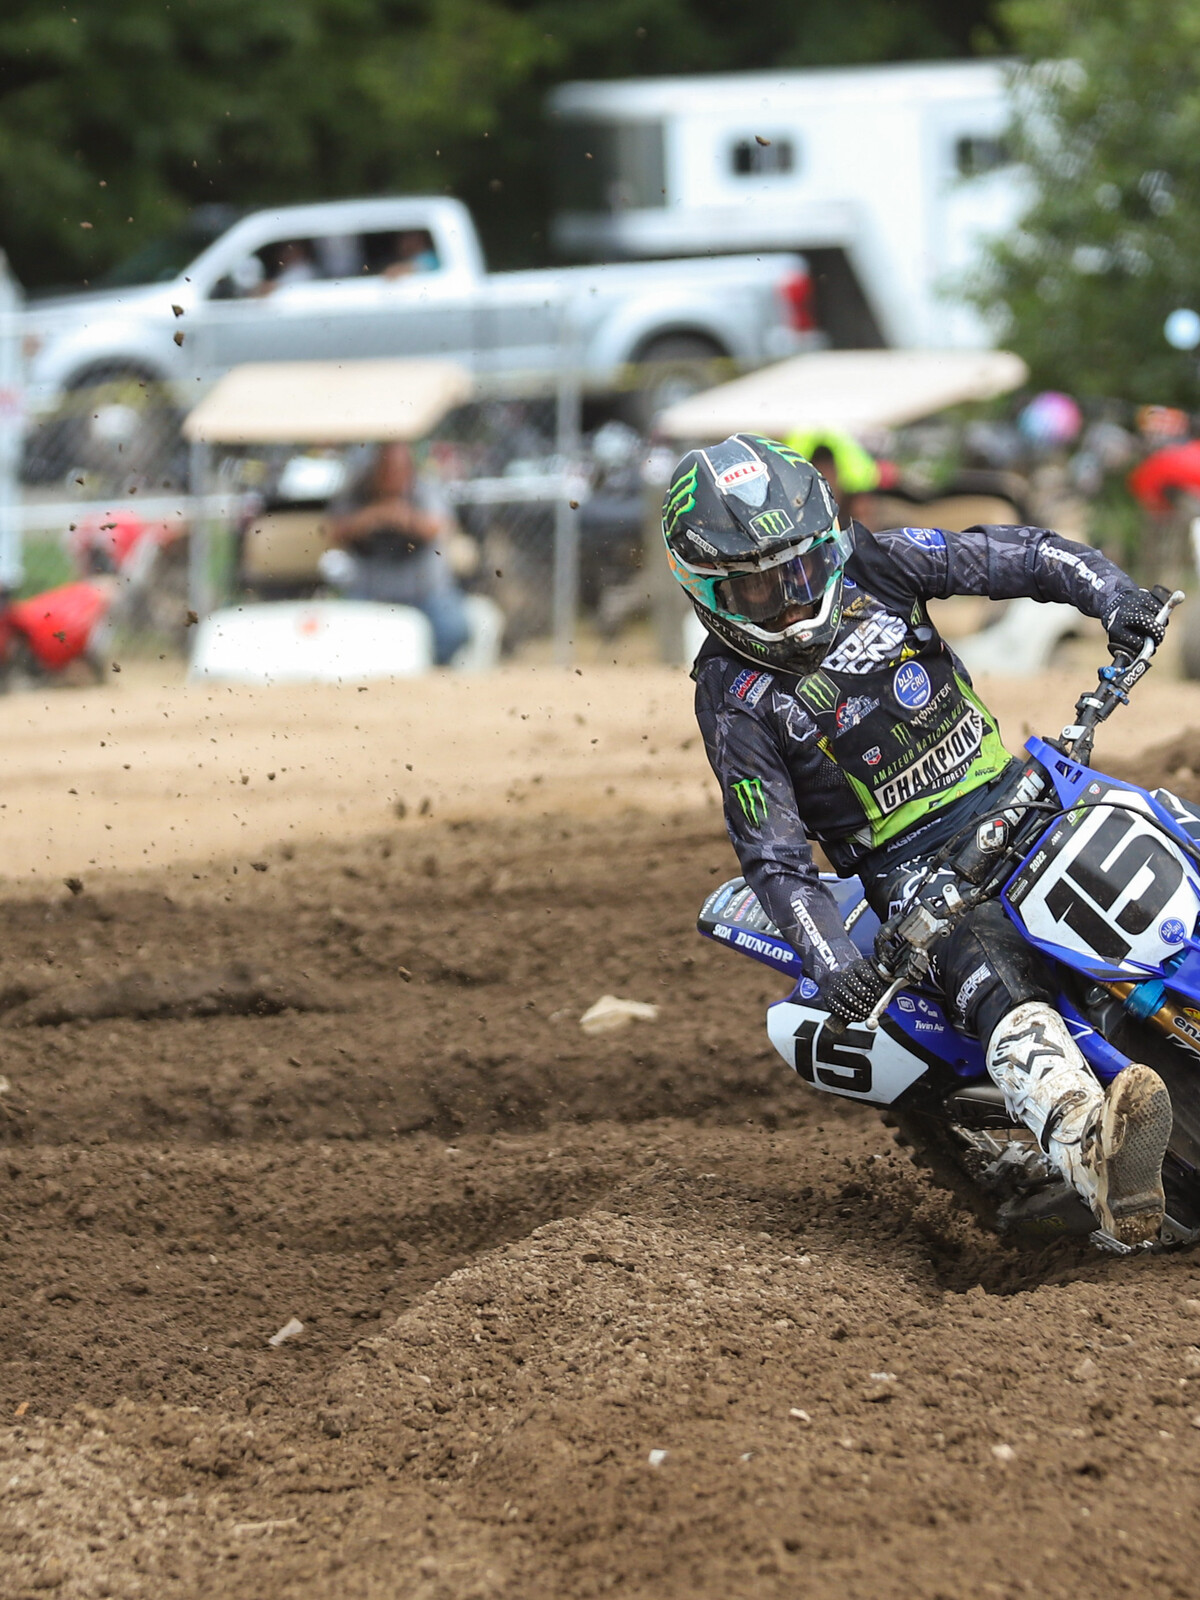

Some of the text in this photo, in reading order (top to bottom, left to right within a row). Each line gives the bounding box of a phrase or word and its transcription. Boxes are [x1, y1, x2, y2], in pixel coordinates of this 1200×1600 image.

[724, 463, 758, 484] BELL
[910, 683, 952, 726] MONSTER
[873, 750, 915, 785] AMATEUR
[915, 717, 953, 753] NATIONAL
[931, 780, 942, 790] AT
[1029, 850, 1048, 874] 2022
[1044, 806, 1184, 962] 15
[735, 930, 794, 964] DUNLOP
[915, 1020, 945, 1032] Twin Air
[792, 1019, 877, 1094] 15
